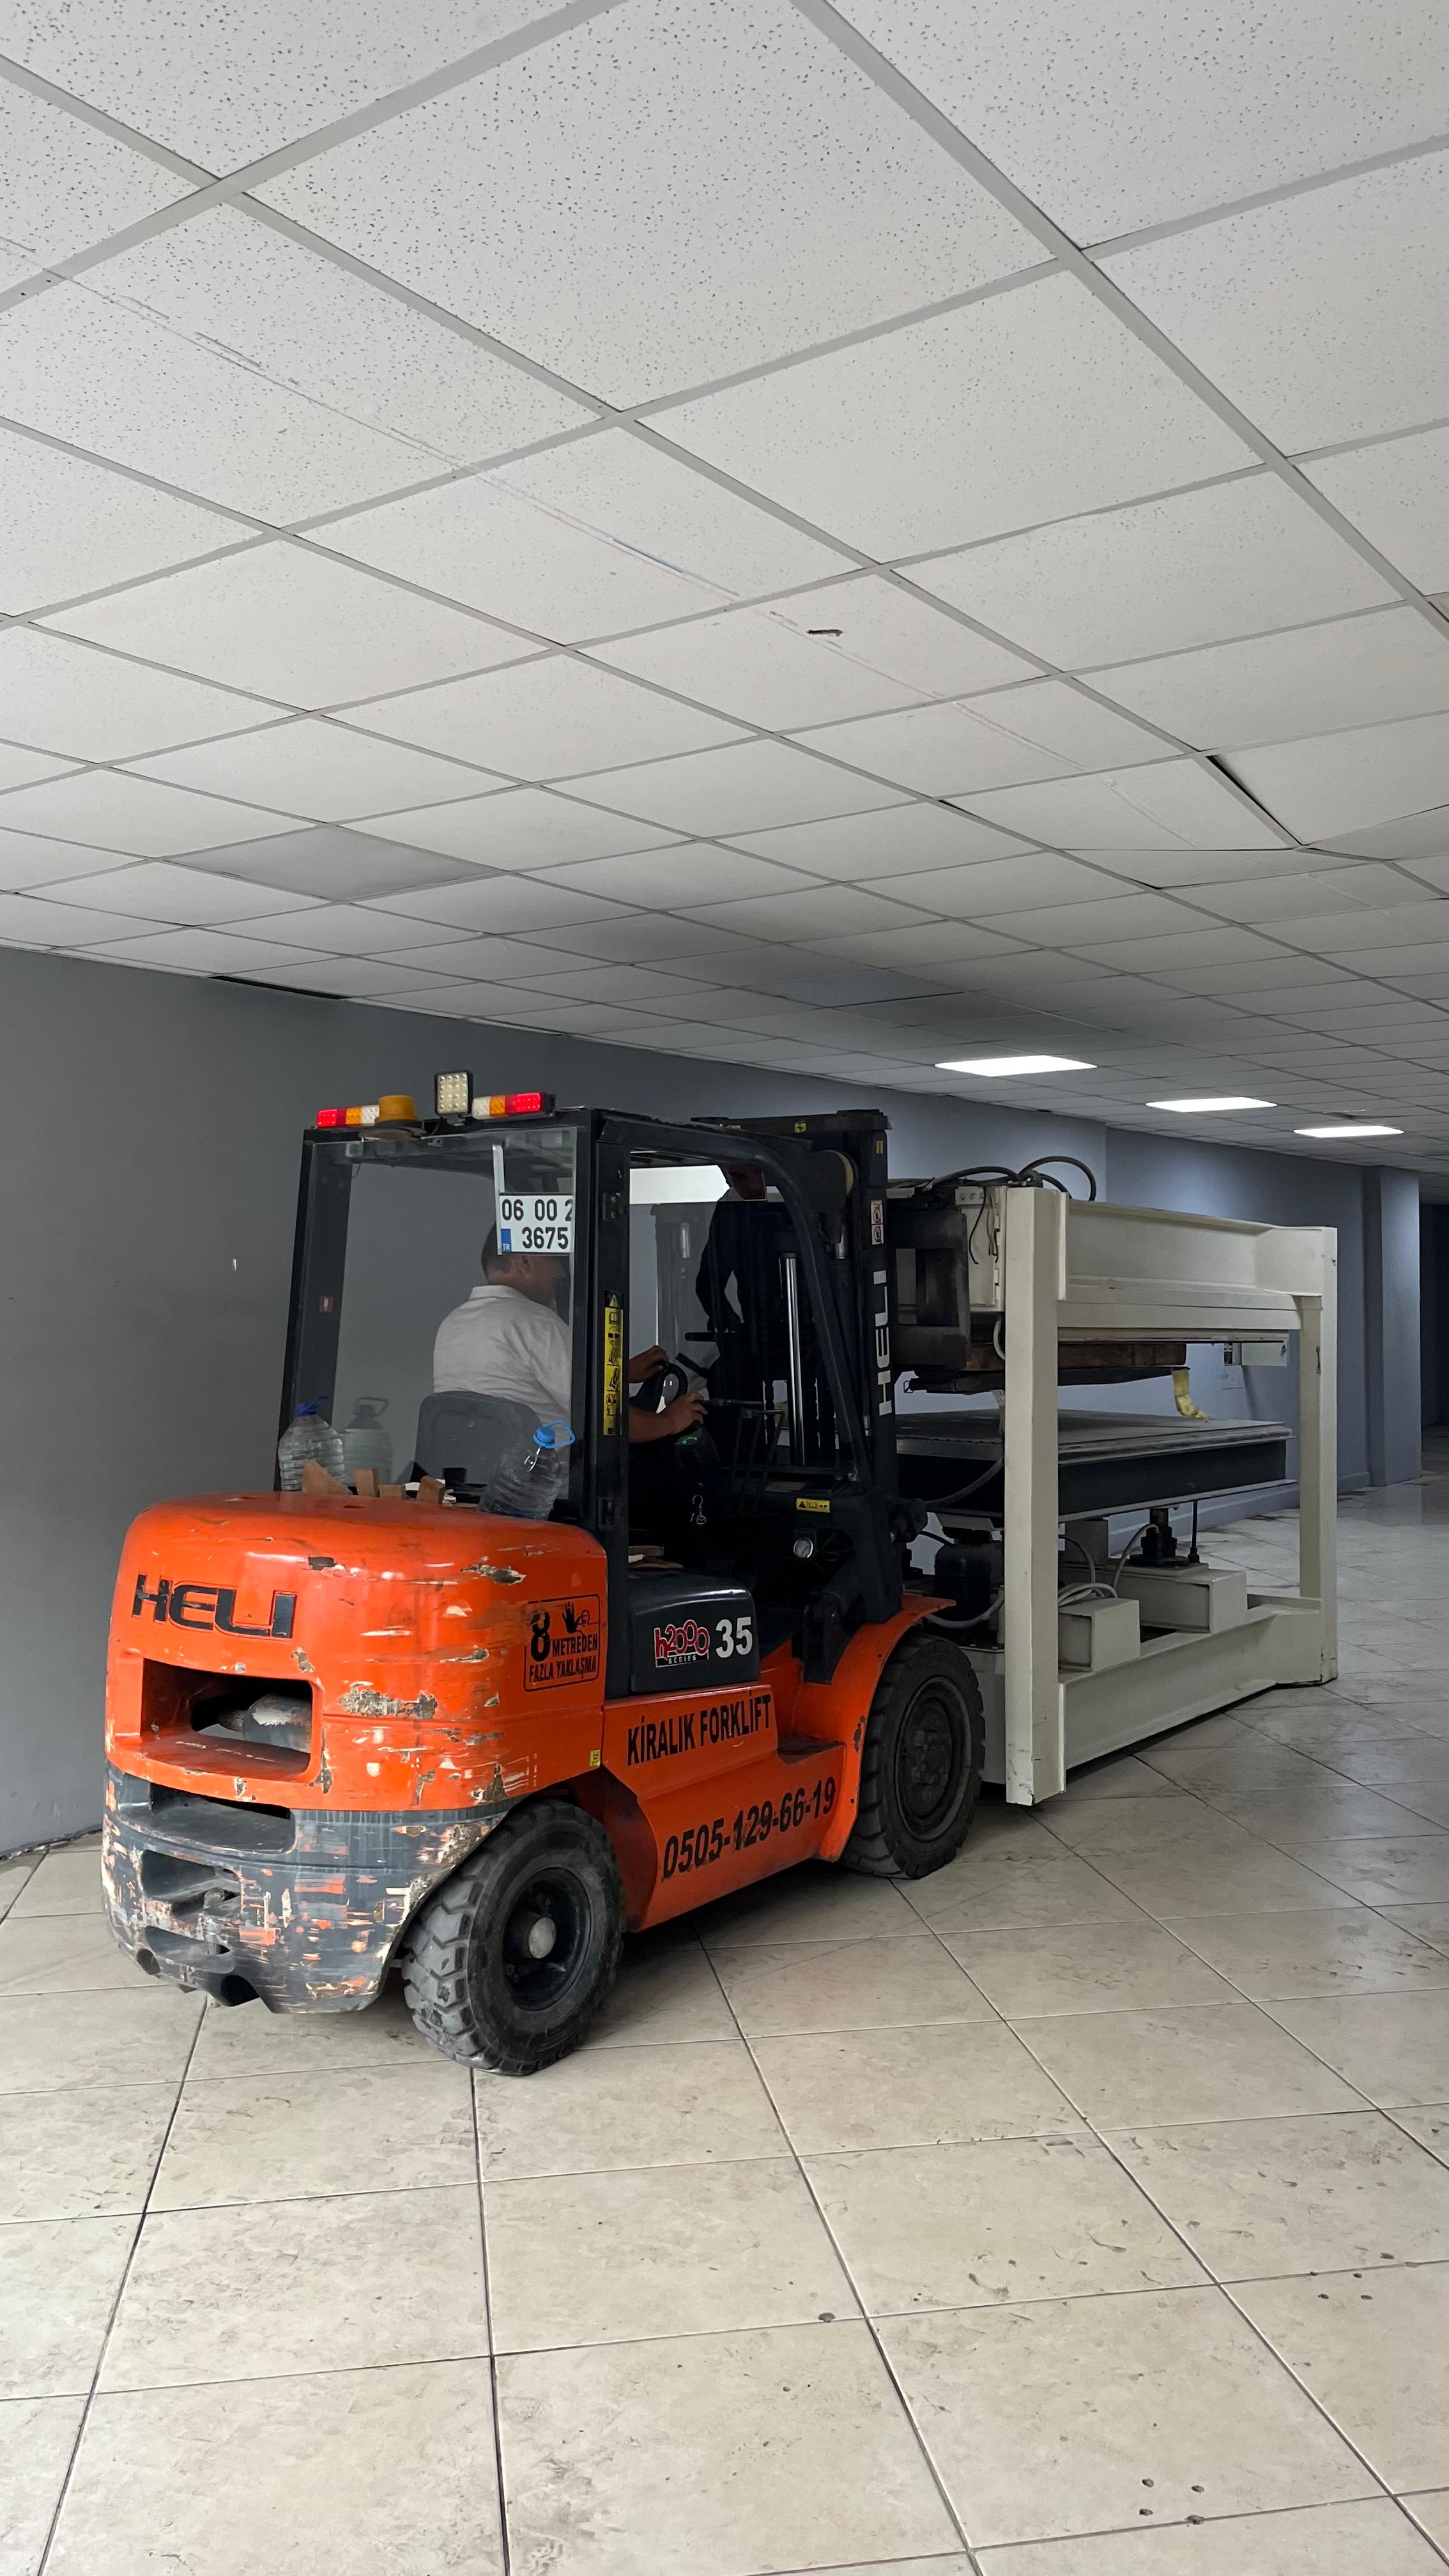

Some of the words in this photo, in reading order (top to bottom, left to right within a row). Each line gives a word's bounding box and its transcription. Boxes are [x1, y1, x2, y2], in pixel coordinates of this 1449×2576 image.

[502, 1199, 524, 1221] 06
[535, 1199, 557, 1221] 00
[522, 1227, 569, 1249] 3675
[873, 1269, 893, 1416] HELI
[132, 1572, 298, 1641] HELI
[530, 1611, 551, 1662] 8
[552, 1632, 598, 1658] METREDEN
[654, 1619, 710, 1660] h2000
[716, 1616, 753, 1659] 35
[668, 1654, 696, 1664] SERIES
[529, 1662, 554, 1683] FAZLA
[556, 1655, 597, 1680] YAKLAŞMA
[627, 1715, 696, 1767] KİRALIK
[700, 1690, 772, 1747] FORKLİFT
[663, 1776, 836, 1879] 0505-129-66-19
